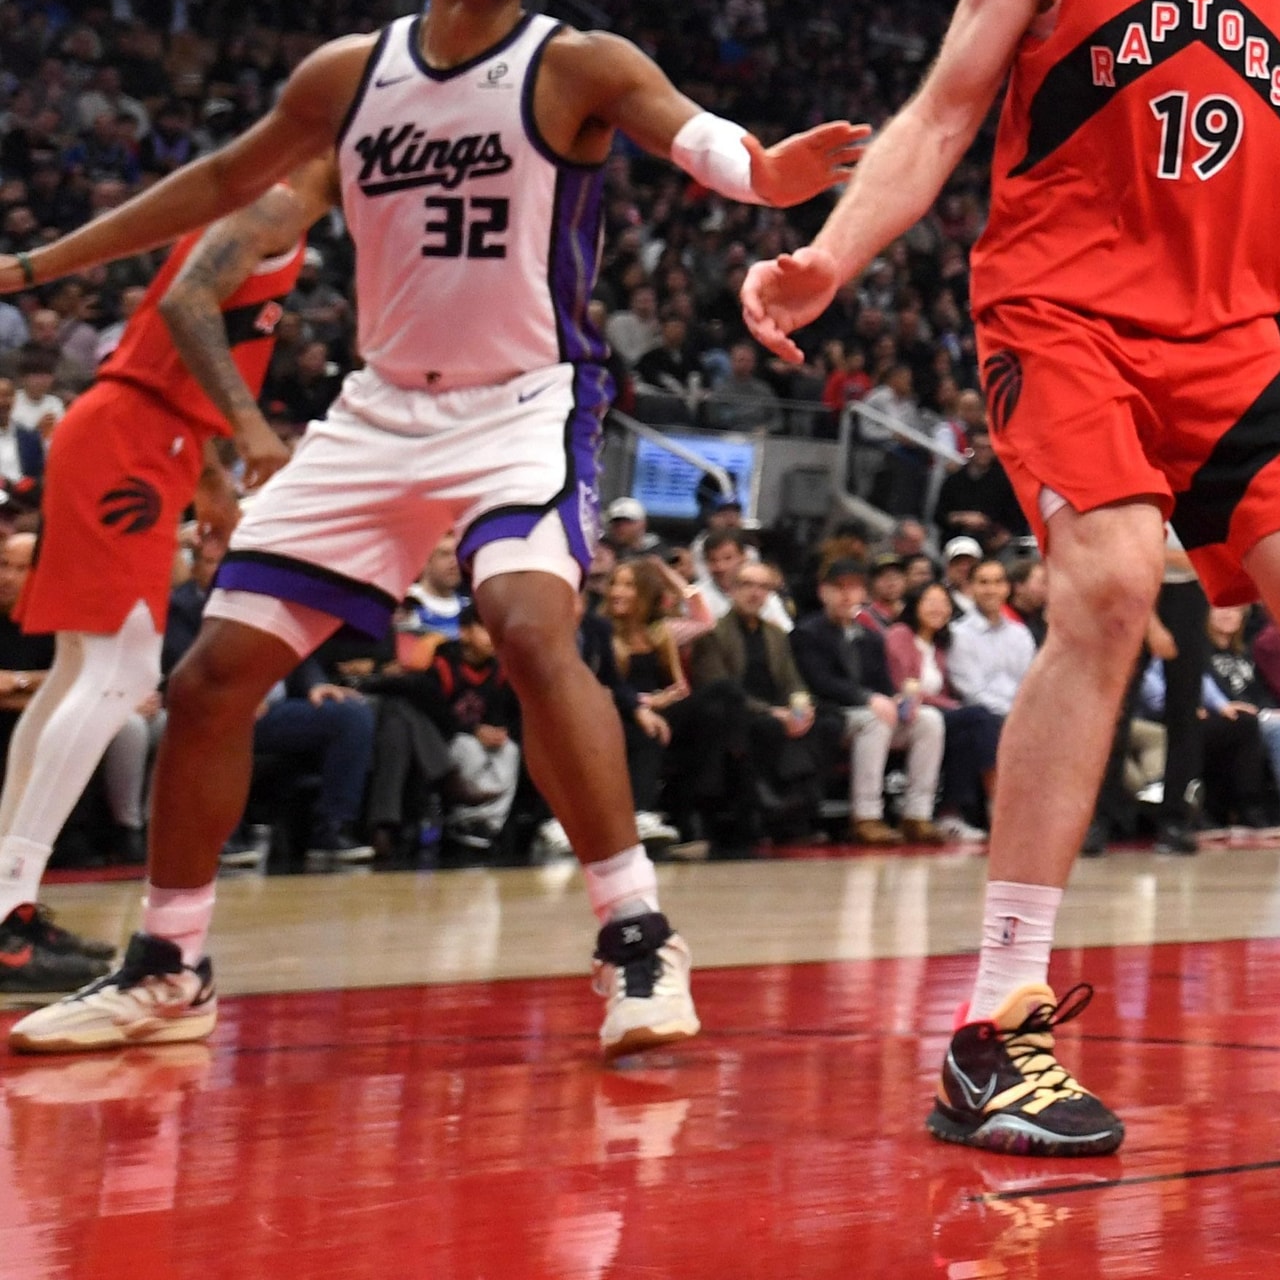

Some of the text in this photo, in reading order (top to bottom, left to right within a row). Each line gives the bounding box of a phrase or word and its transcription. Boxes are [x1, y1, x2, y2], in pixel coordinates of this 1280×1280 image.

[355, 122, 513, 197] Kings
[1149, 90, 1244, 180] 19
[421, 195, 510, 258] 32
